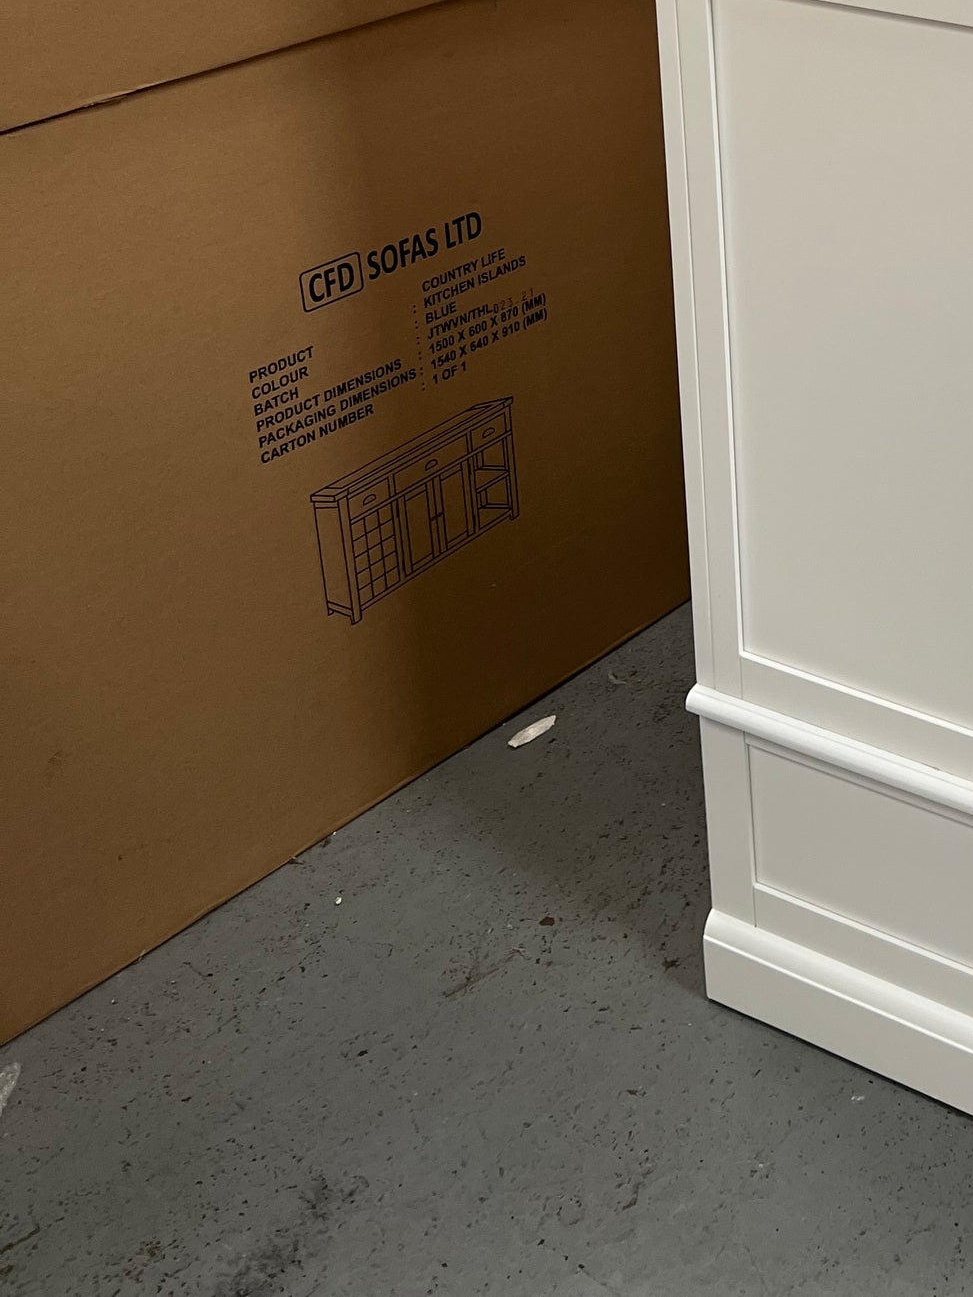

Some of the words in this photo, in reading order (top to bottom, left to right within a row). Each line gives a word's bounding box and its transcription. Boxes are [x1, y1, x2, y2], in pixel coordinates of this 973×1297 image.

[309, 262, 354, 302] CFD
[368, 227, 438, 280] SOFAS
[445, 212, 481, 249] LTD
[422, 259, 478, 292] COUNTRY
[481, 248, 506, 268] LIFE
[249, 346, 314, 383] PRODUCT
[424, 277, 474, 308] KITCHEN
[478, 256, 526, 286] ISLANDS
[252, 366, 309, 399] COLOUR
[425, 302, 457, 324] BLUE
[254, 387, 299, 416] BATCH
[428, 304, 493, 340] JTWVN/THL
[257, 394, 321, 432] PRODUCT
[324, 359, 402, 402] DIMENSIONS
[429, 334, 454, 354] 1500
[458, 330, 465, 343] X
[469, 320, 487, 338] 600
[490, 316, 498, 329] X
[501, 306, 518, 322] 870
[522, 293, 546, 314] (MM)
[259, 403, 337, 448] PACKAGING
[340, 368, 417, 412] DIMENSIONS
[431, 350, 456, 369] 1540
[459, 344, 467, 358] X
[470, 336, 489, 352] 640
[492, 330, 500, 343] X
[502, 321, 520, 338] 910
[523, 308, 548, 330] (MM)
[261, 431, 316, 464] CARTON
[319, 404, 374, 438] NUMBER
[433, 373, 438, 384] 1
[442, 365, 457, 380] OF
[461, 361, 466, 372] 1
